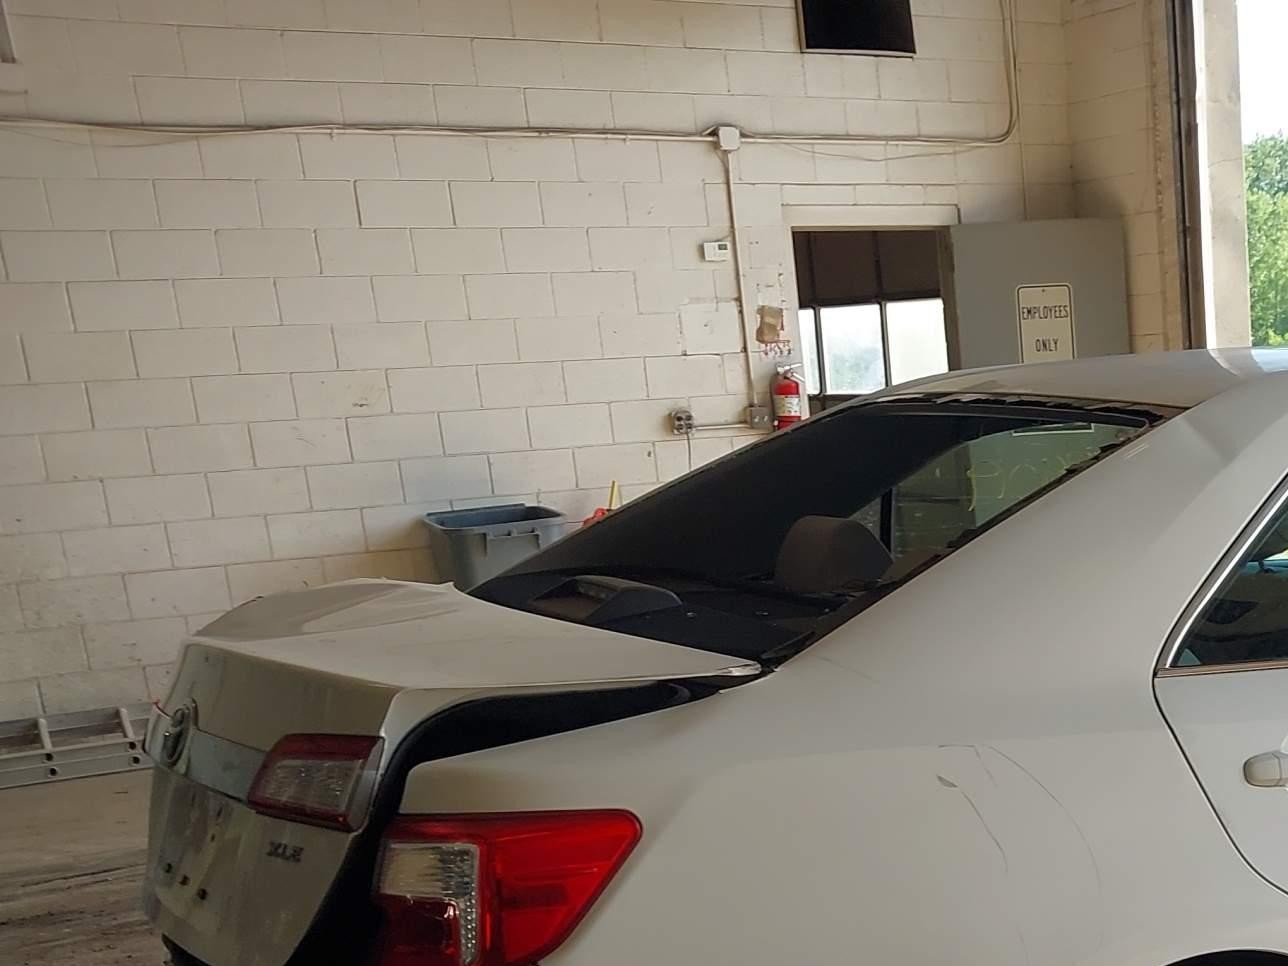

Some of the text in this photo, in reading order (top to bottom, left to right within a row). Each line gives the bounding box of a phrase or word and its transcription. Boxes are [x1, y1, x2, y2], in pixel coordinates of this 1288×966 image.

[1021, 305, 1069, 320] EMPLOYEES
[1035, 338, 1059, 352] ONLY
[266, 841, 304, 863] XLE
